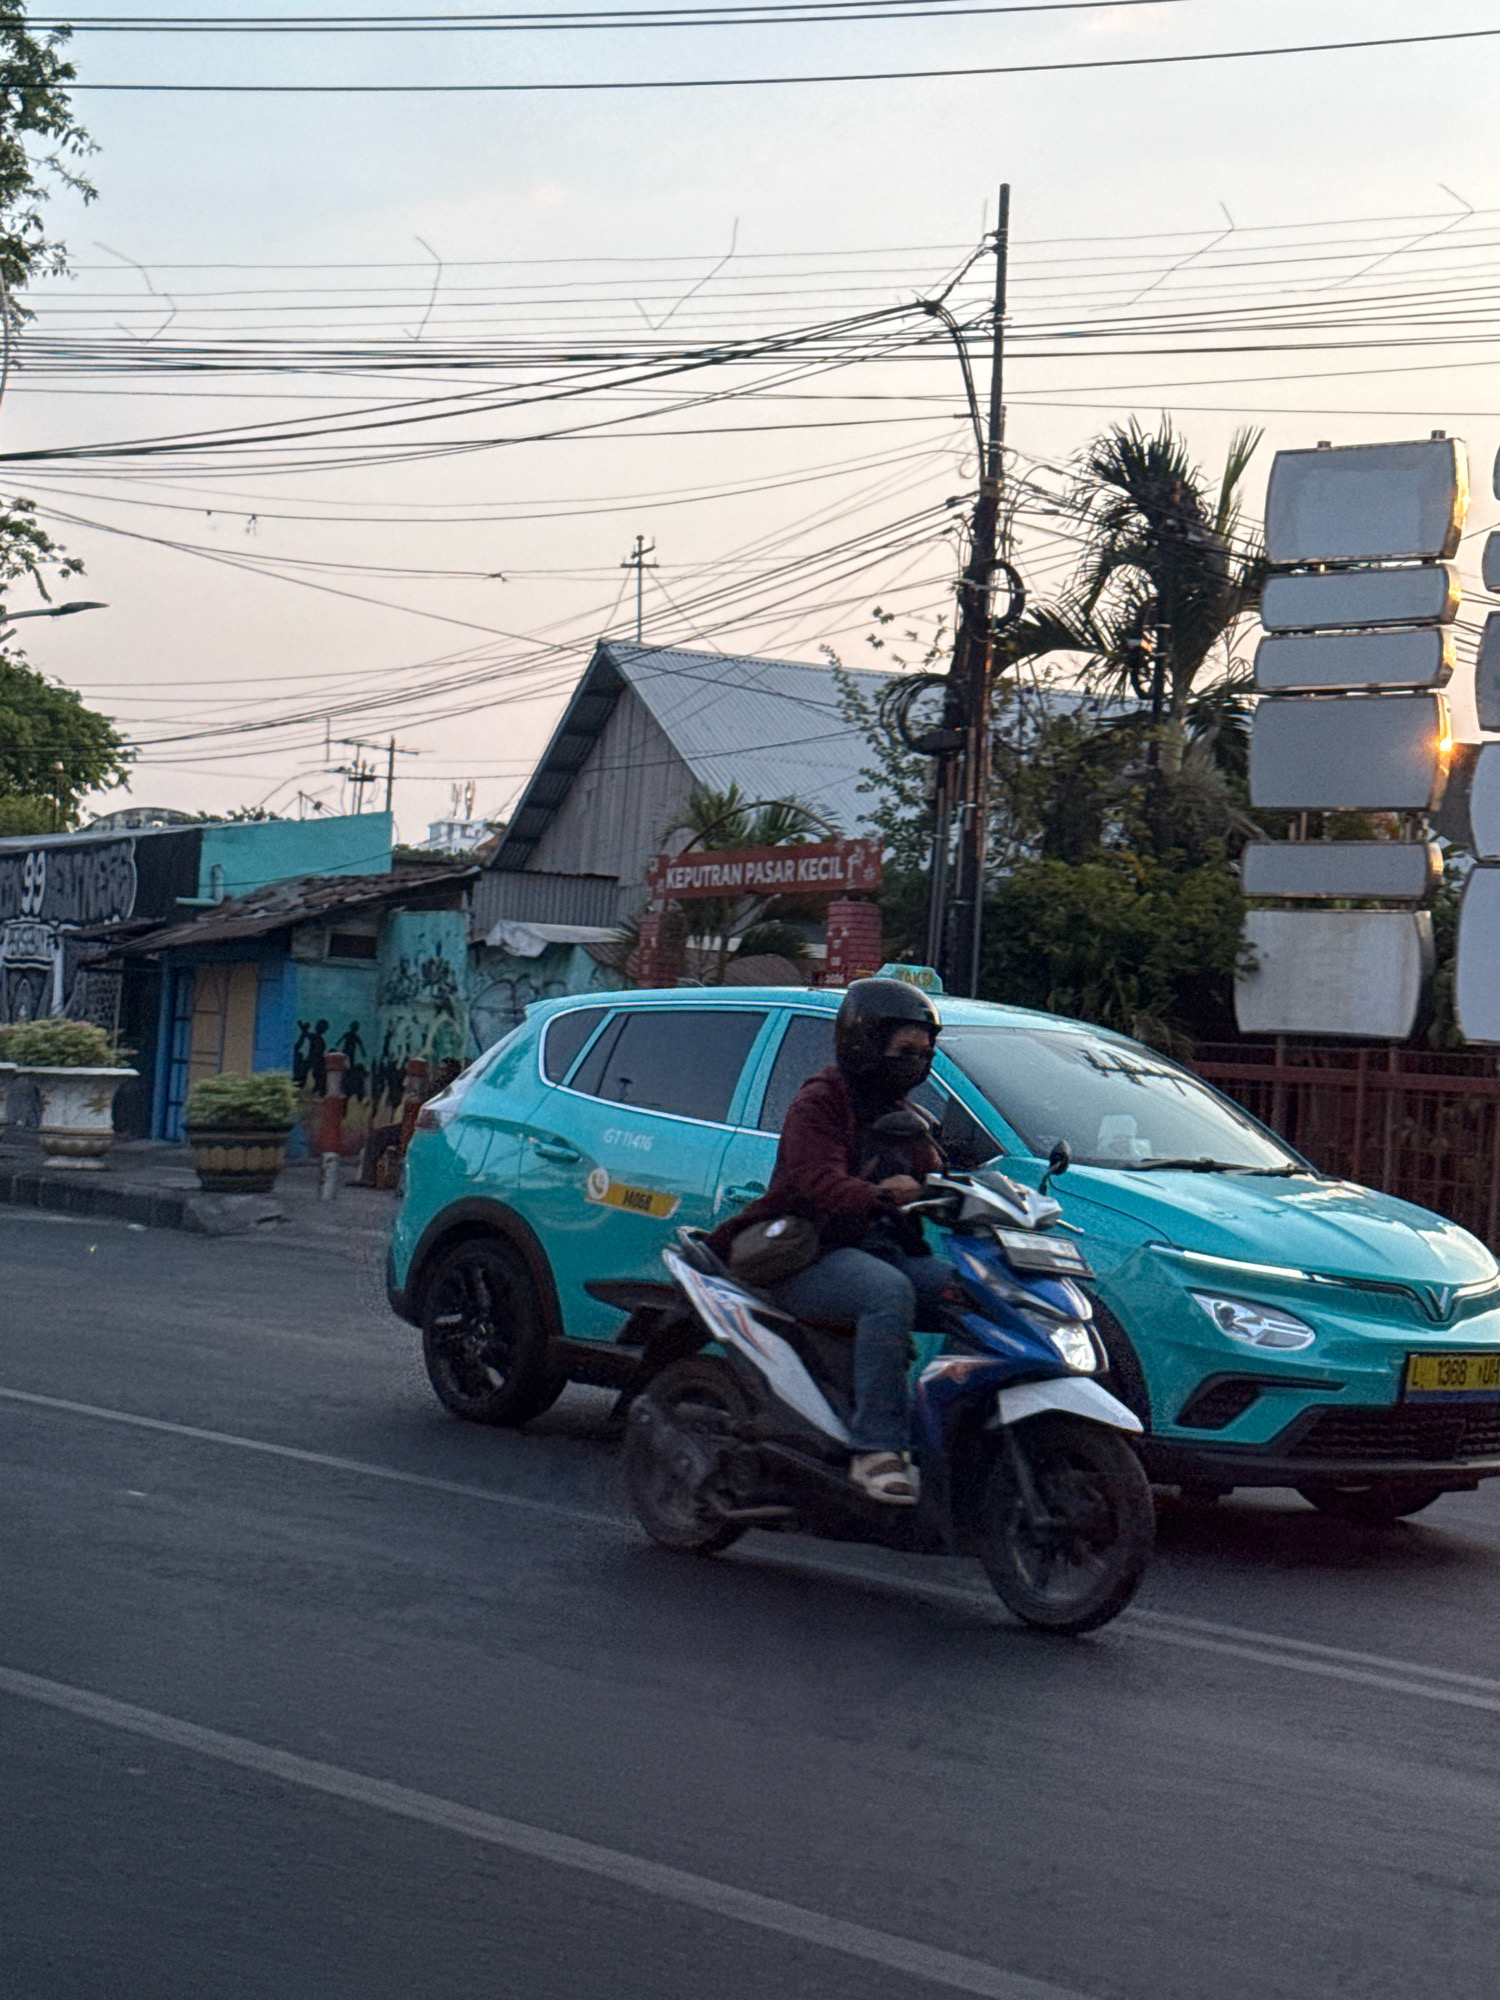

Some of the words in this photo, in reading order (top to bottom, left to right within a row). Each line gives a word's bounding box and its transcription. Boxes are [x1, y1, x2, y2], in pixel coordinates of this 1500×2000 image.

[666, 863, 743, 889] KEPUTRAN
[745, 860, 795, 885] PASAR
[797, 856, 844, 881] KECIL
